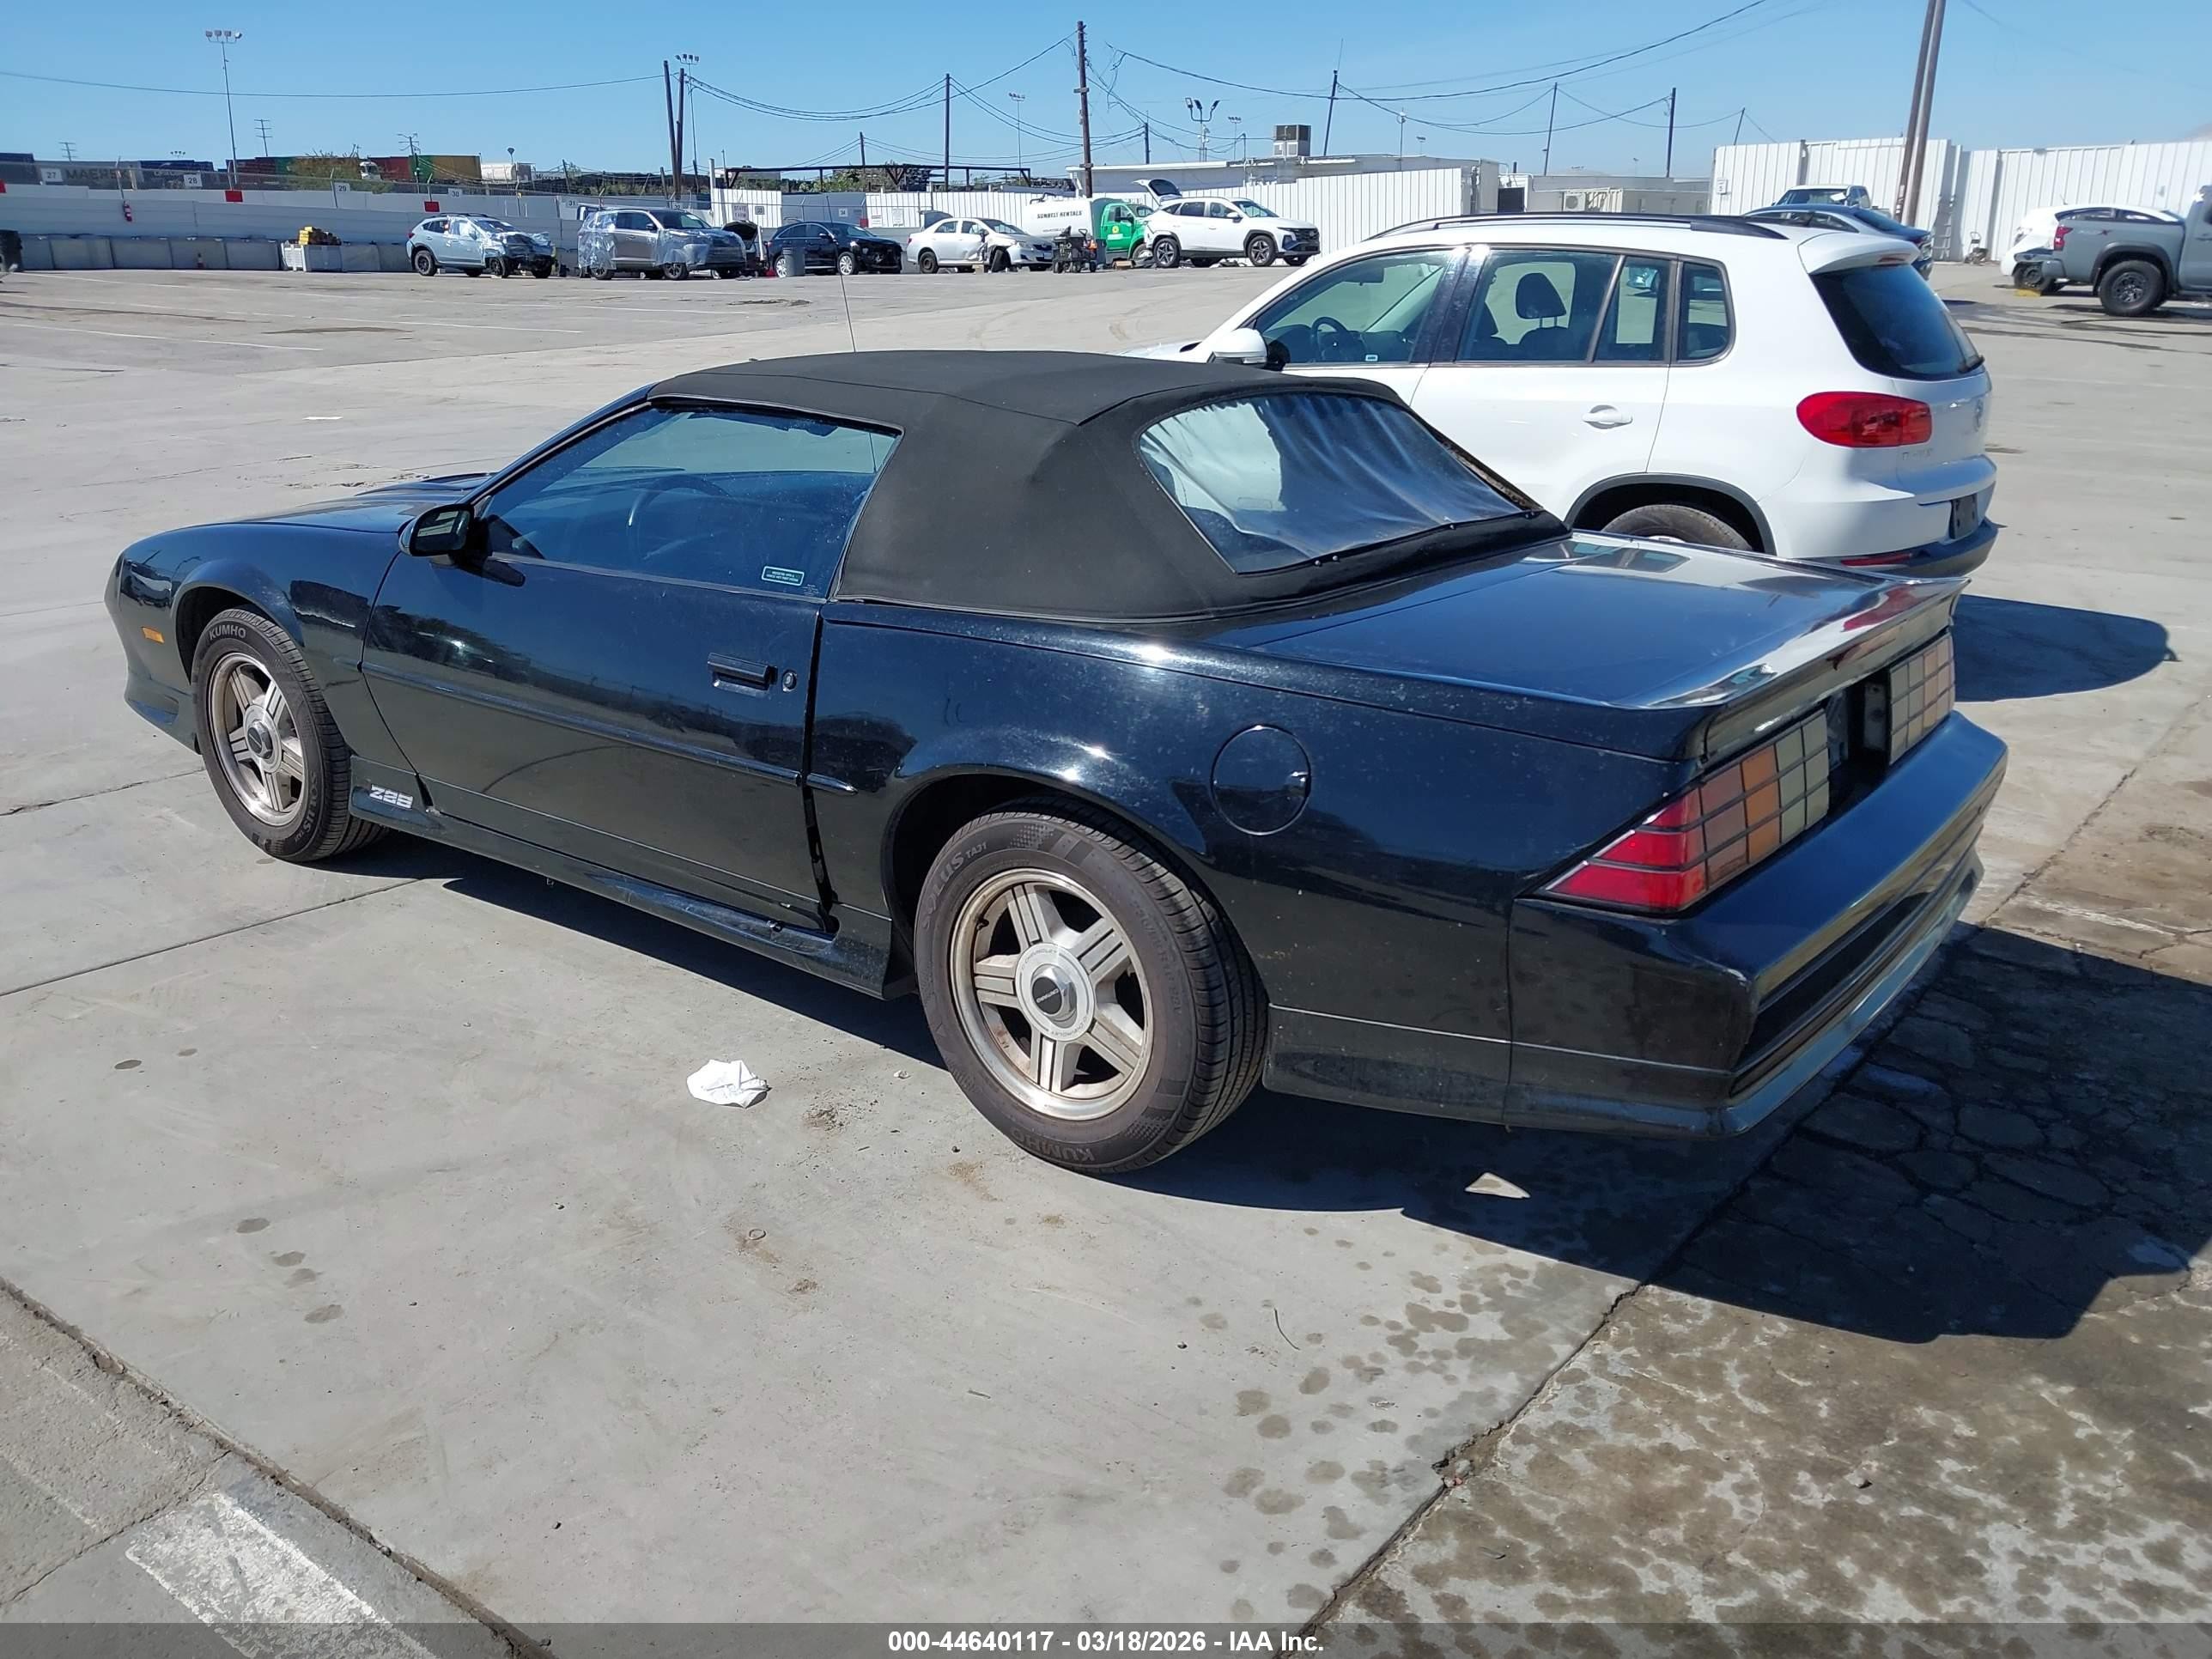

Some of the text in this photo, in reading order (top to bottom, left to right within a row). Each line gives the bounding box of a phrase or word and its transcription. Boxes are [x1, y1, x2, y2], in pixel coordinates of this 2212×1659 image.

[209, 624, 246, 641] KUMHO
[921, 842, 988, 930] SOLUS TA31
[1013, 1127, 1095, 1162] KUMHO
